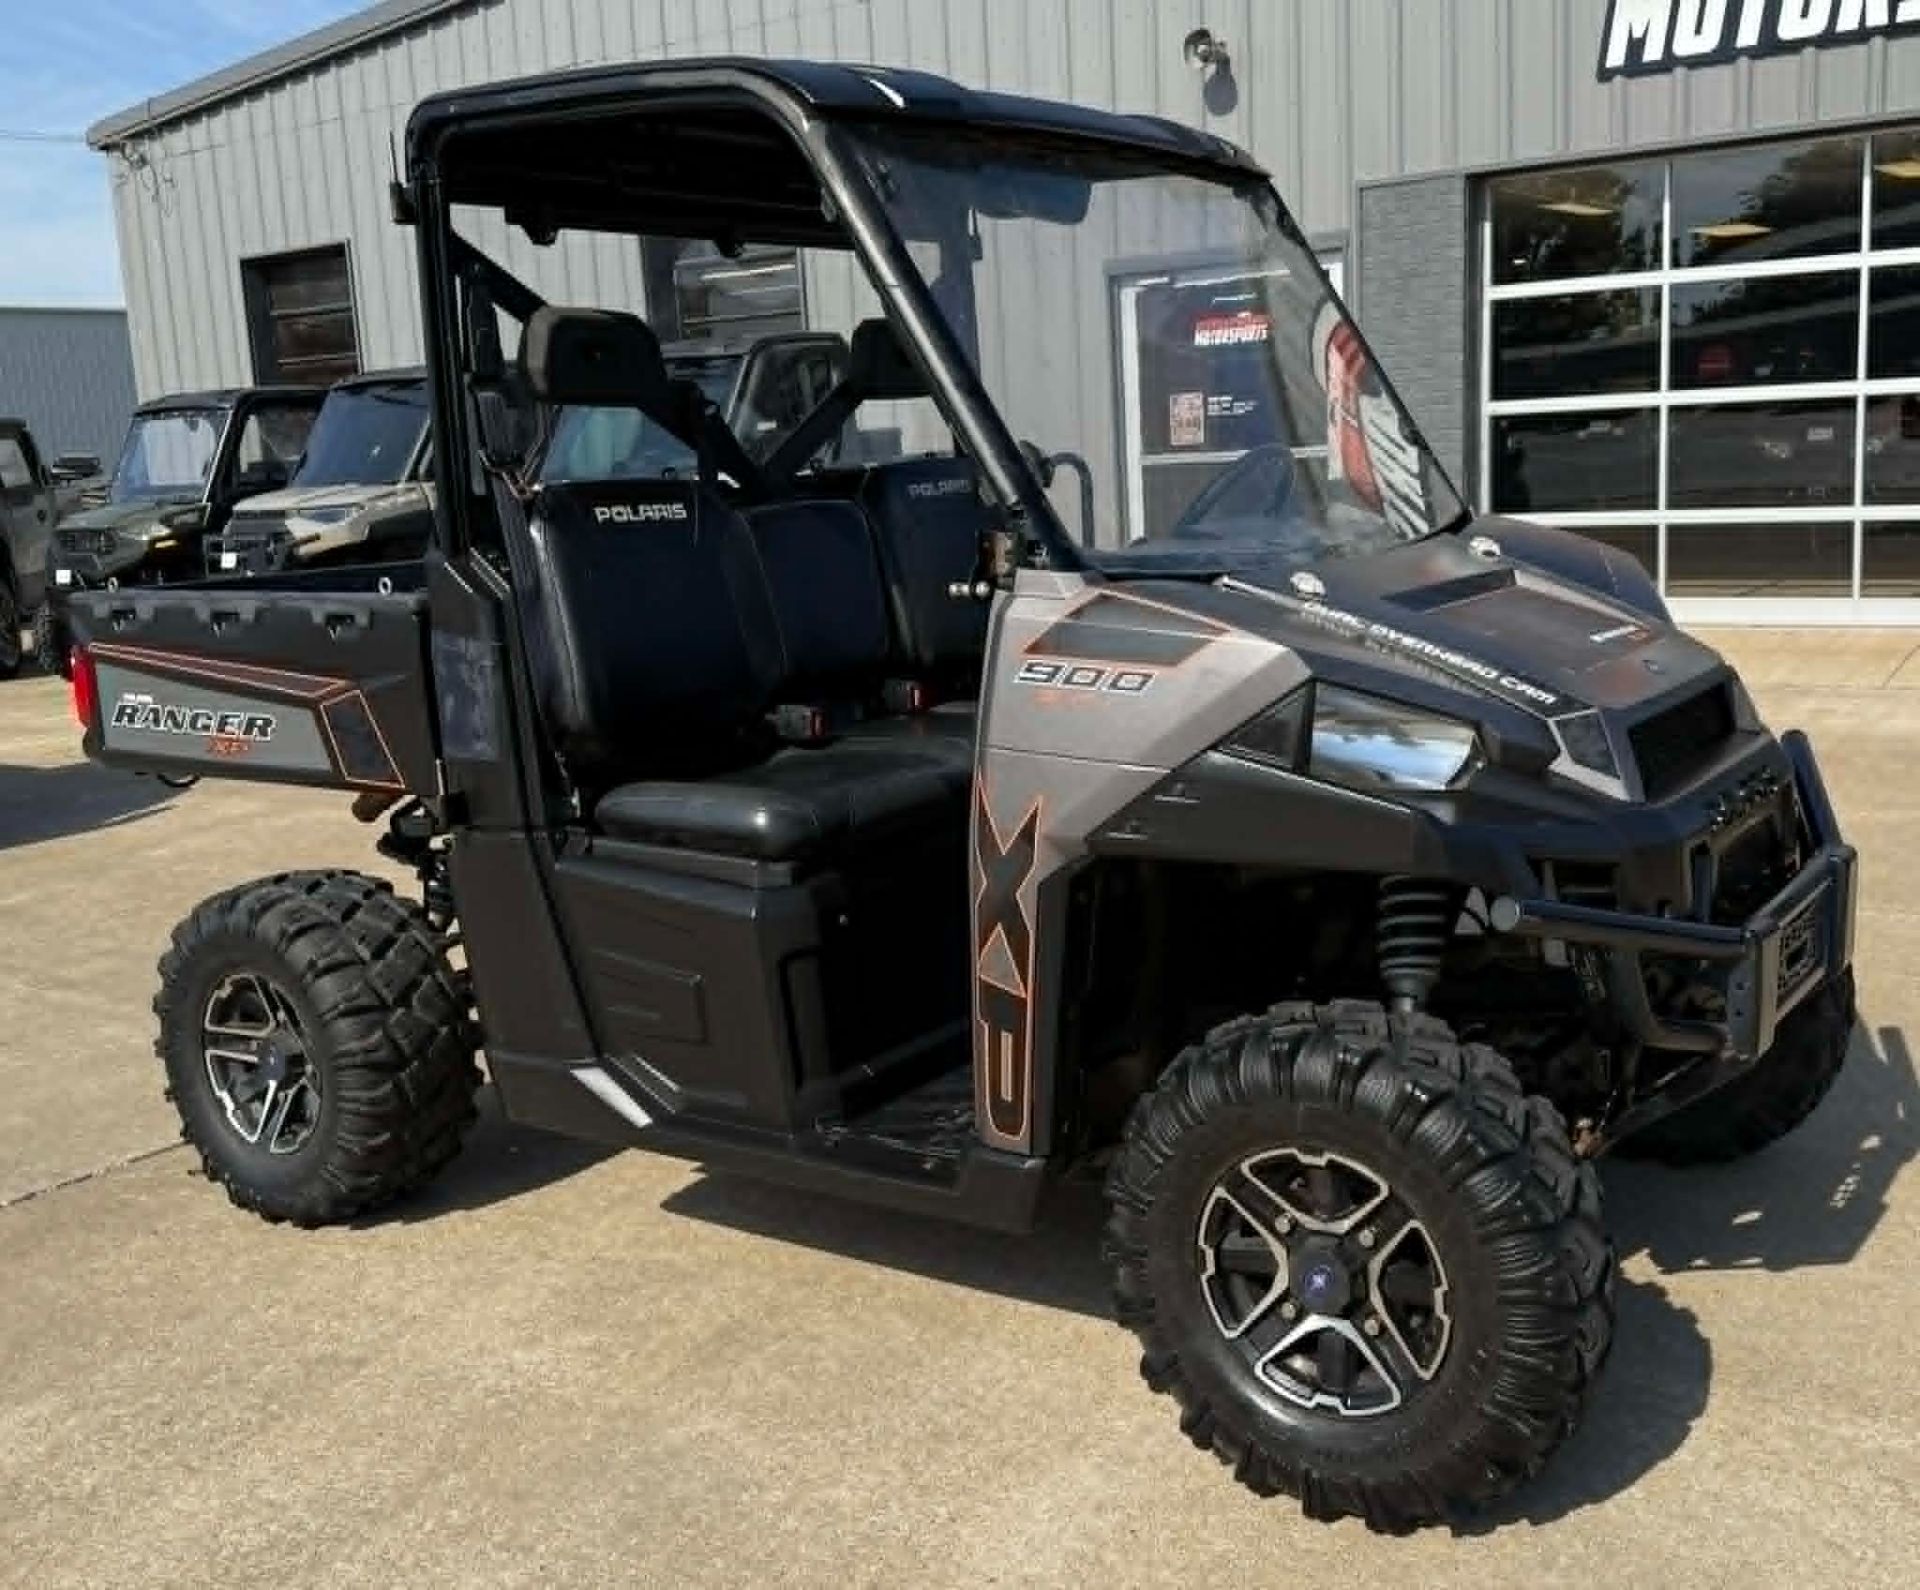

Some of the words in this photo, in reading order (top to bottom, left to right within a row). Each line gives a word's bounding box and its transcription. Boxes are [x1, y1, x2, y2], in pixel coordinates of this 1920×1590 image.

[592, 502, 688, 525] POLARIS
[1015, 660, 1157, 696] 900
[112, 703, 277, 742] RANGER
